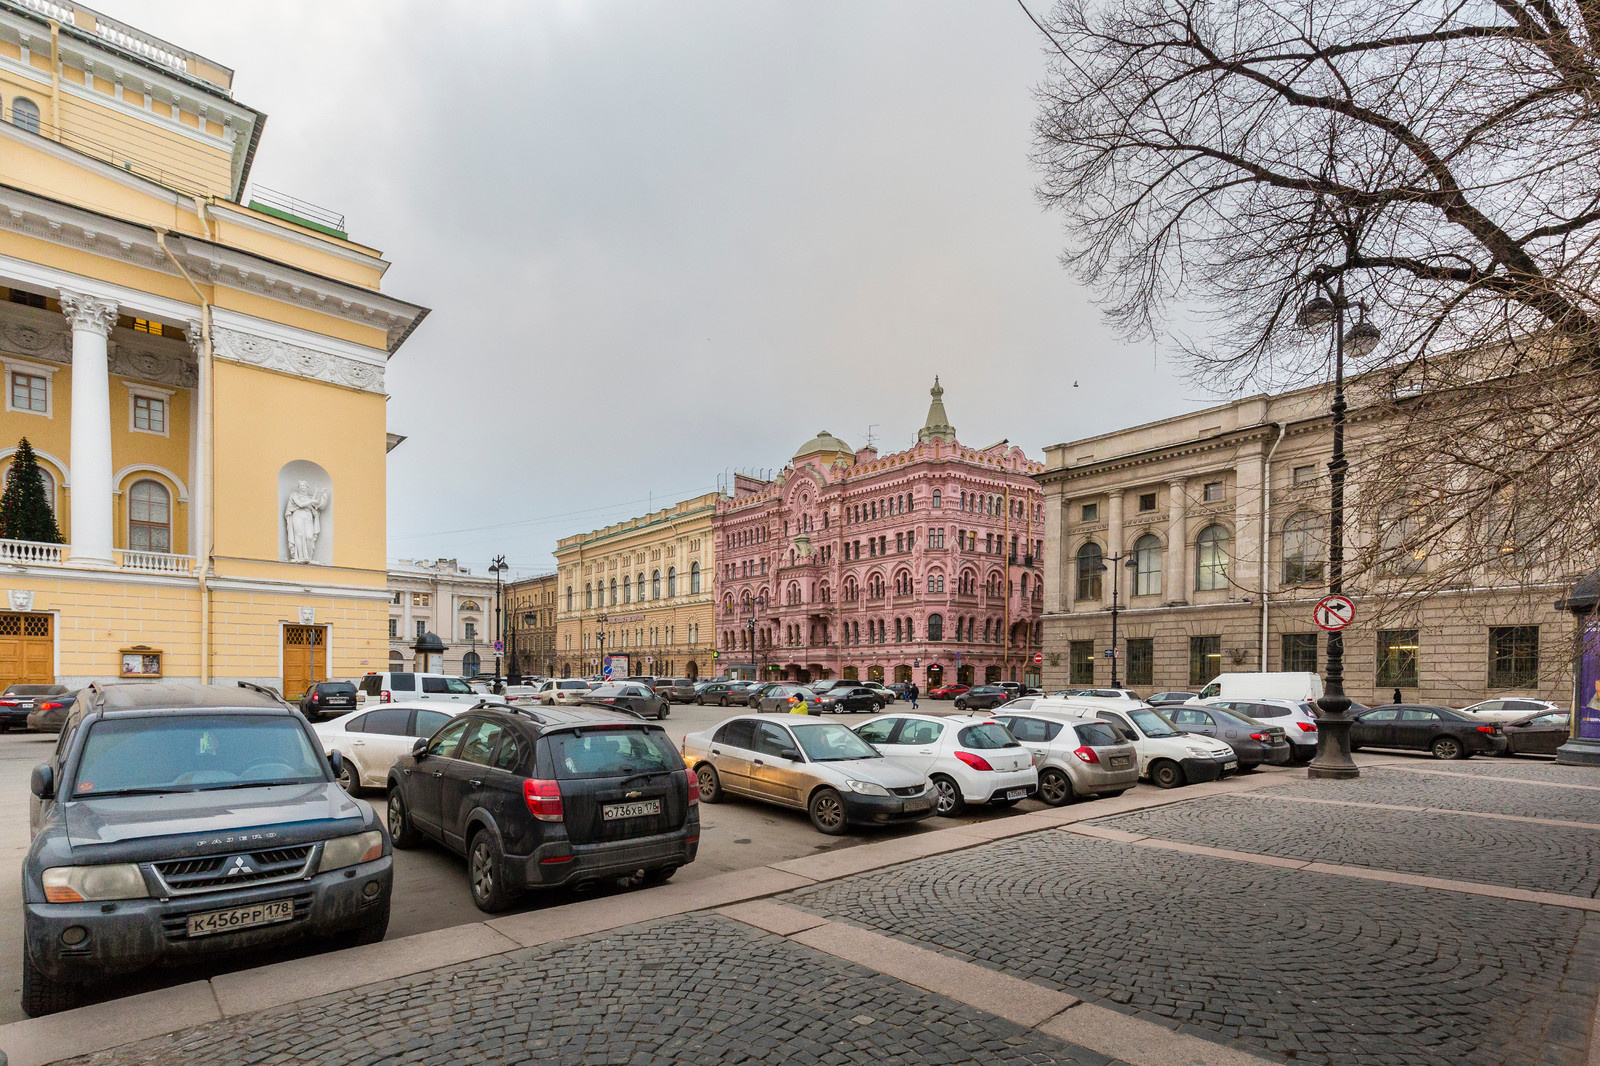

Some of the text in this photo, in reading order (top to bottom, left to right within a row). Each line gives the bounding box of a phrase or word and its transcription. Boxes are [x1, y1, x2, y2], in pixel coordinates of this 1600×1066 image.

[645, 802, 657, 811] 178
[197, 832, 277, 847] PAJERO
[194, 902, 290, 931] К456РР 178
